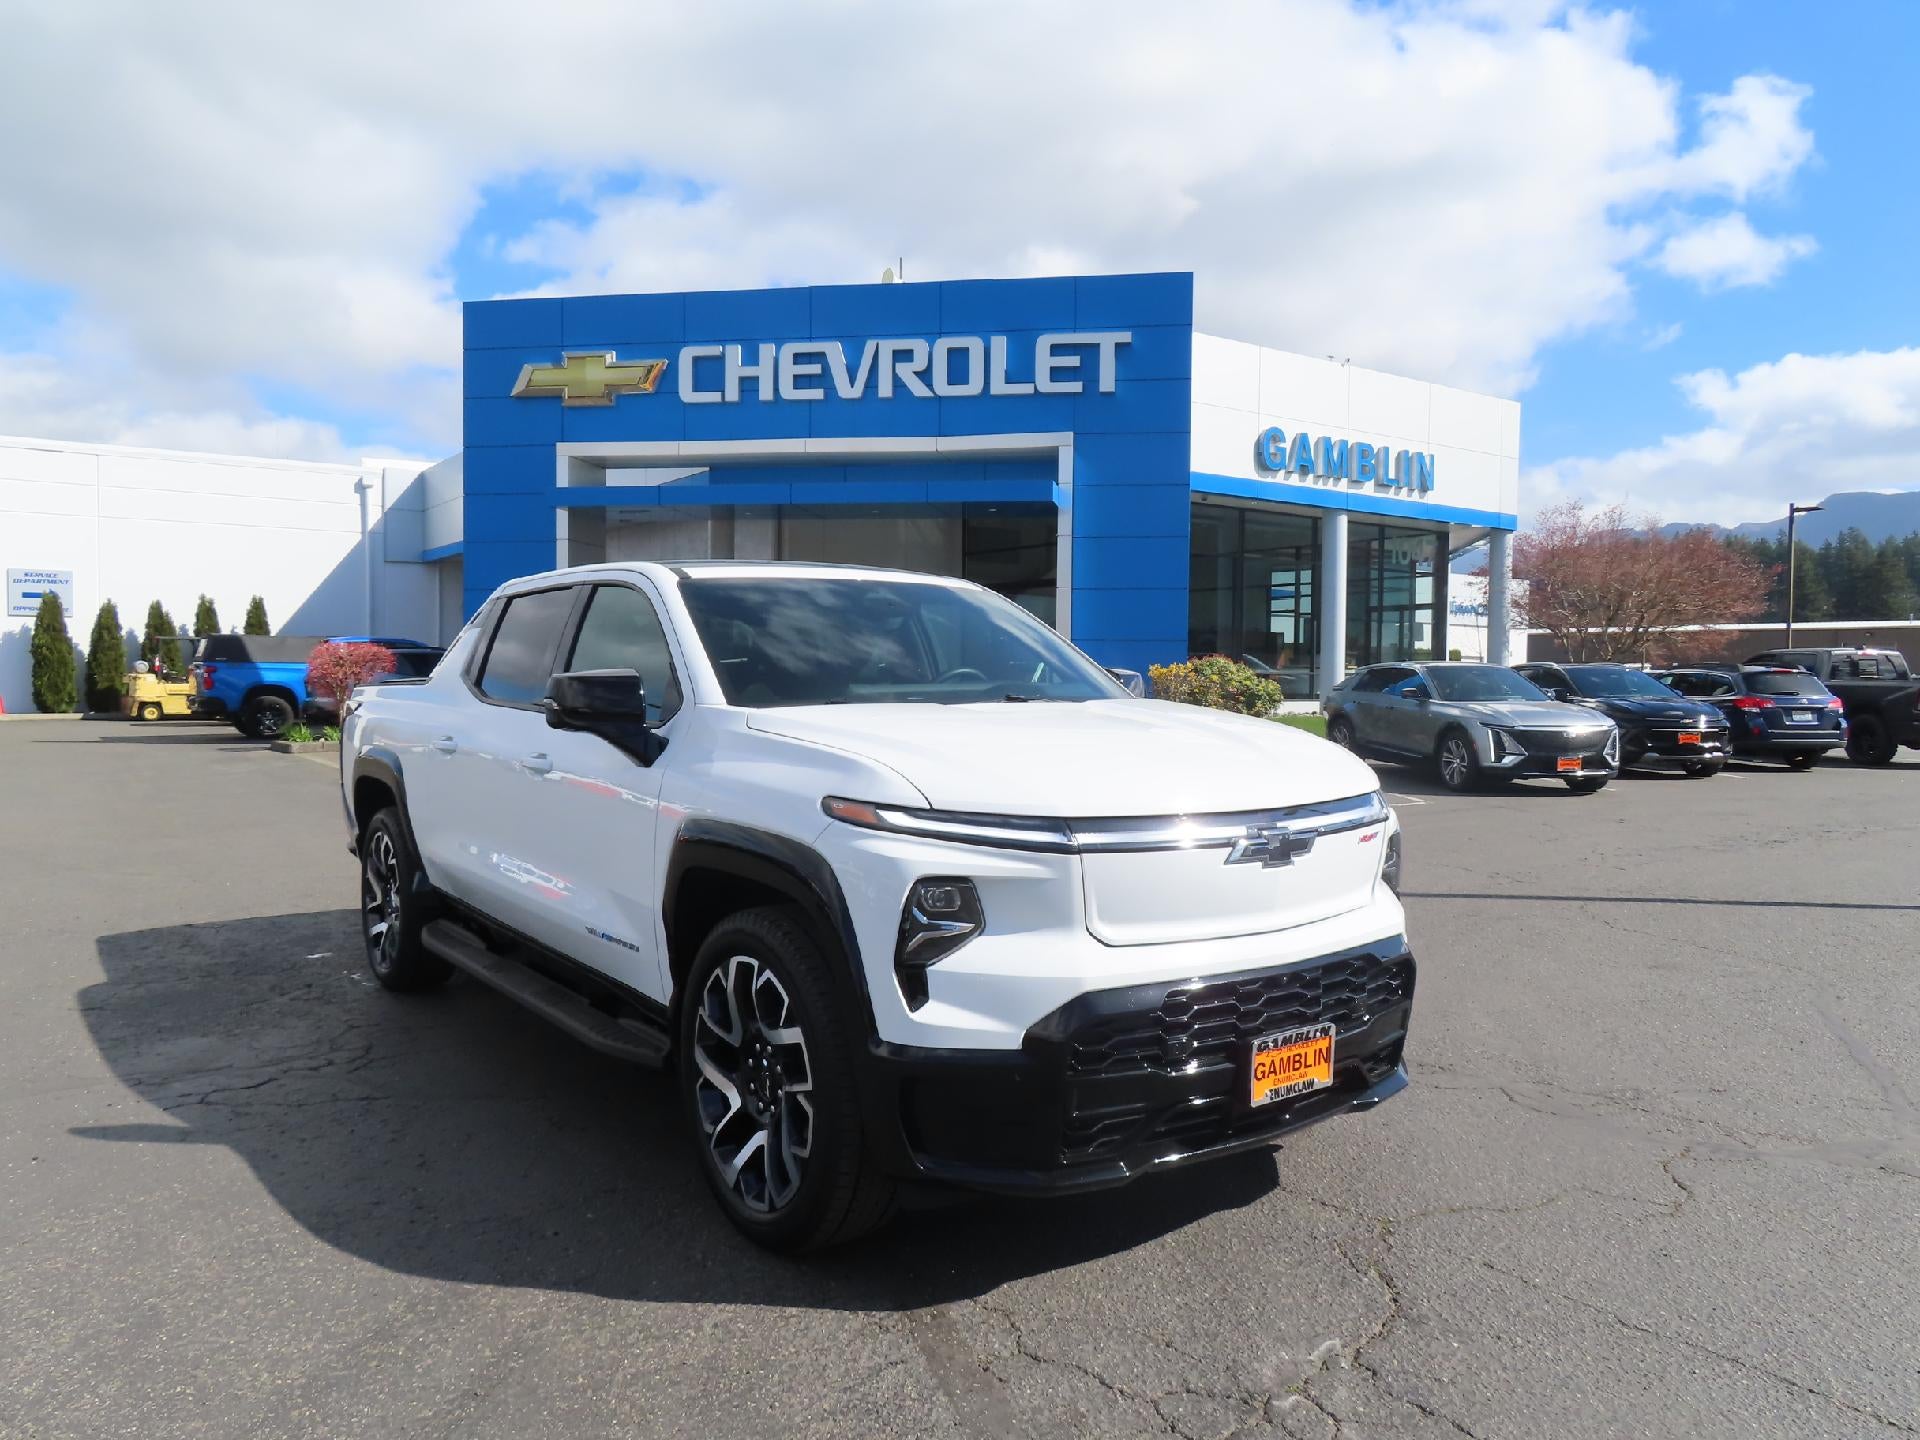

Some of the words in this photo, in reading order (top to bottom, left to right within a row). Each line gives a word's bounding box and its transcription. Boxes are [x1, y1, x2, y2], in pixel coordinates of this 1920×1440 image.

[678, 331, 1132, 403] CHEVROLET
[1254, 426, 1435, 491] GAMBLIN
[1257, 1025, 1332, 1053] GAMBLIN
[1254, 1046, 1331, 1082] GAMBLIN
[1268, 1078, 1315, 1101] ENUMCLAW
